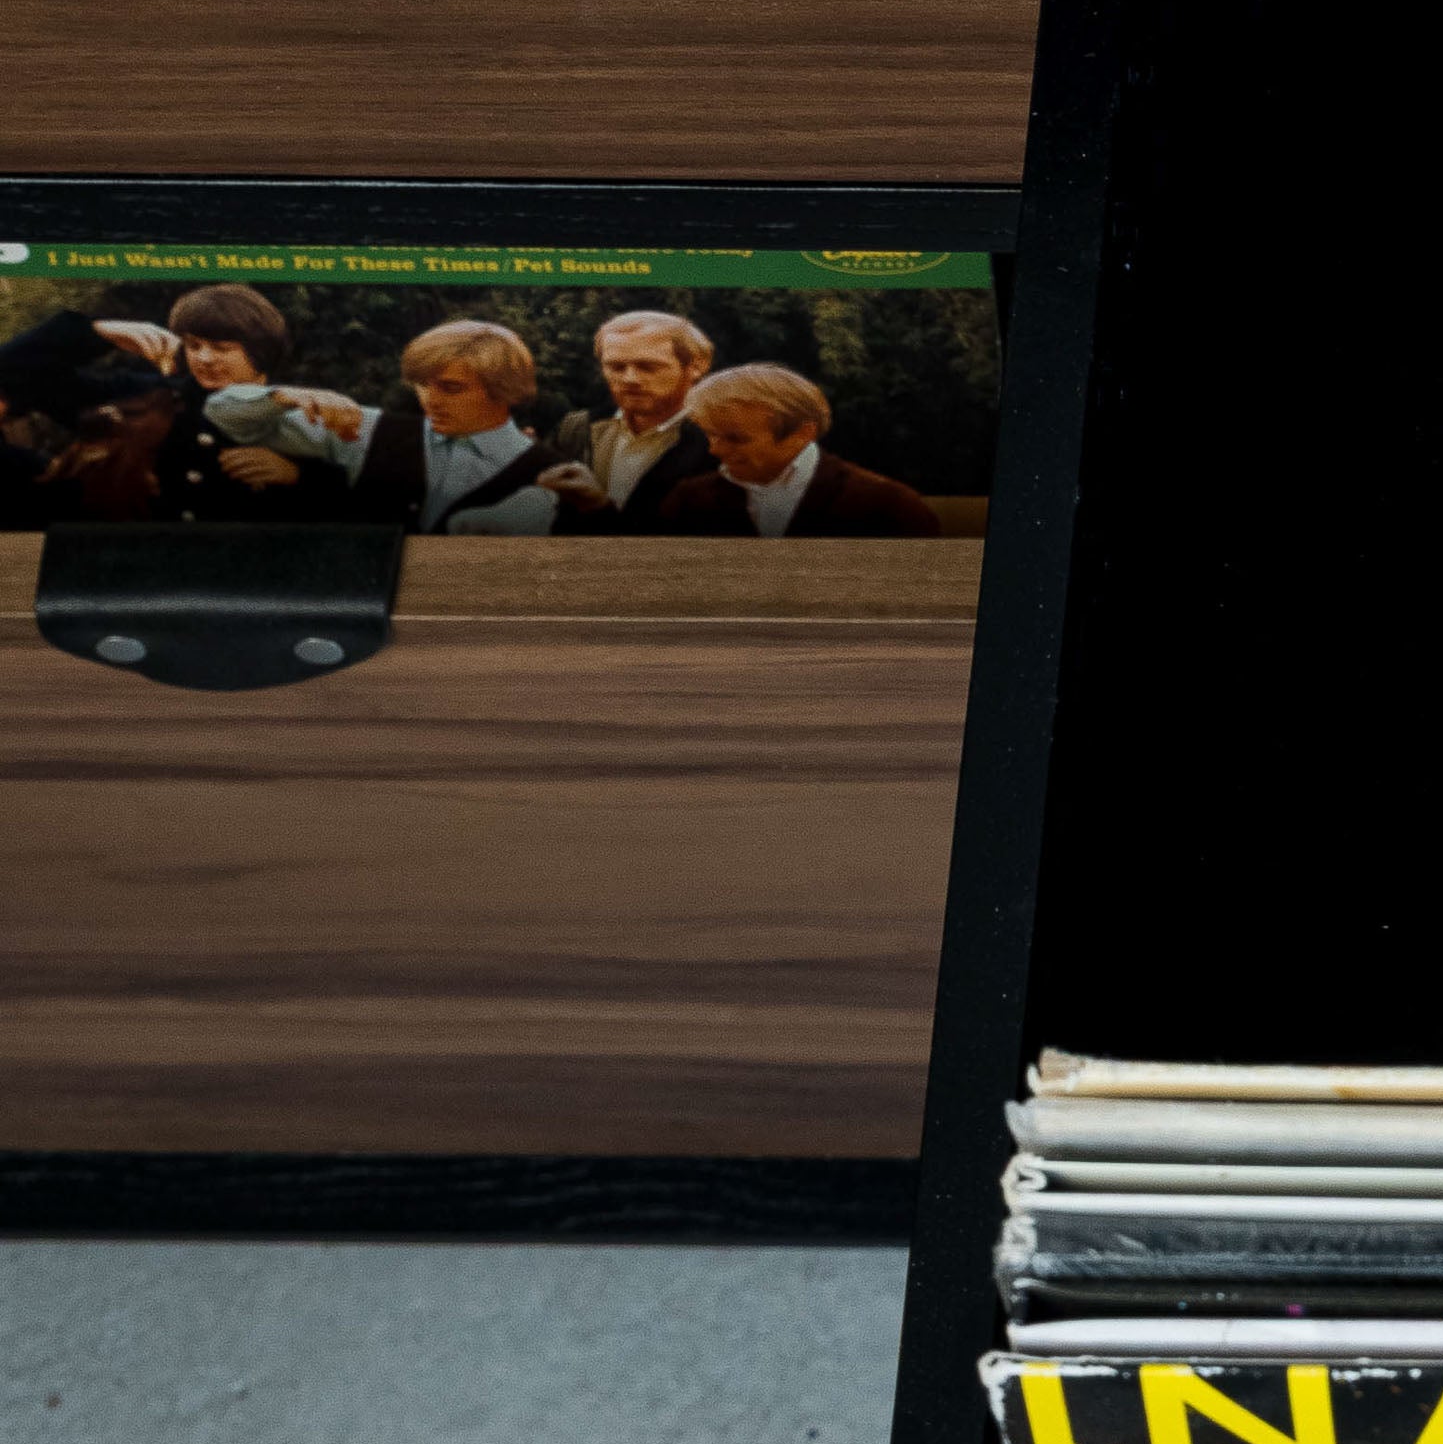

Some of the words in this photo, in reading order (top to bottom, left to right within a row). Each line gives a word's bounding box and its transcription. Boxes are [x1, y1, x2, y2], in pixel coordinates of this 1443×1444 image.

[47, 251, 58, 266] I
[67, 251, 116, 267] Just
[124, 252, 208, 269] Wasn't
[215, 253, 285, 270] Made
[292, 254, 336, 271] For
[342, 255, 416, 272] These
[560, 258, 652, 275] Sounds
